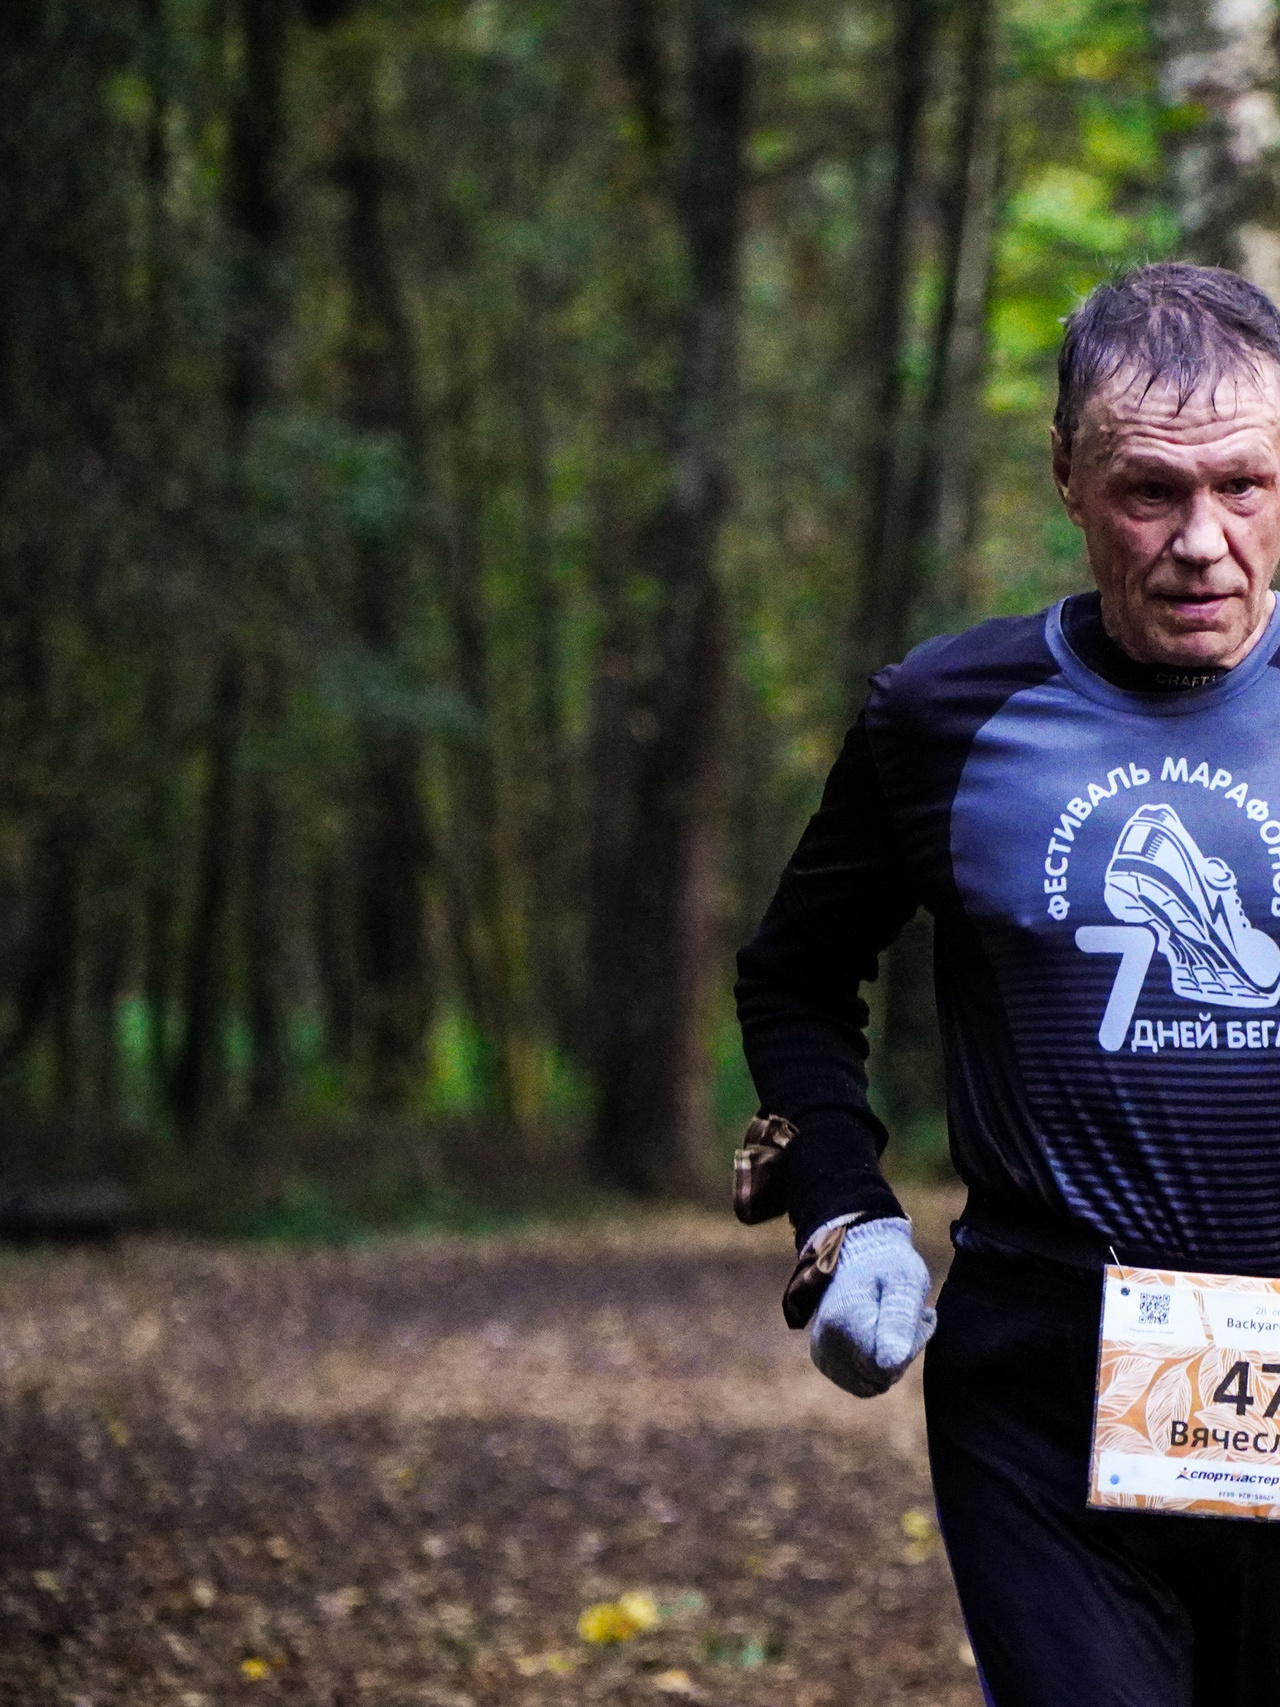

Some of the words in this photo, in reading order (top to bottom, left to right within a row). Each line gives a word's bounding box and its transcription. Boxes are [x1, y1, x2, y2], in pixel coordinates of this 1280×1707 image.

[1044, 762, 1151, 920] ФЕСТИВАЛЬ
[1074, 926, 1156, 1051] 7
[1132, 1012, 1216, 1052] ДНЕЙ
[1256, 1307, 1266, 1315] 28
